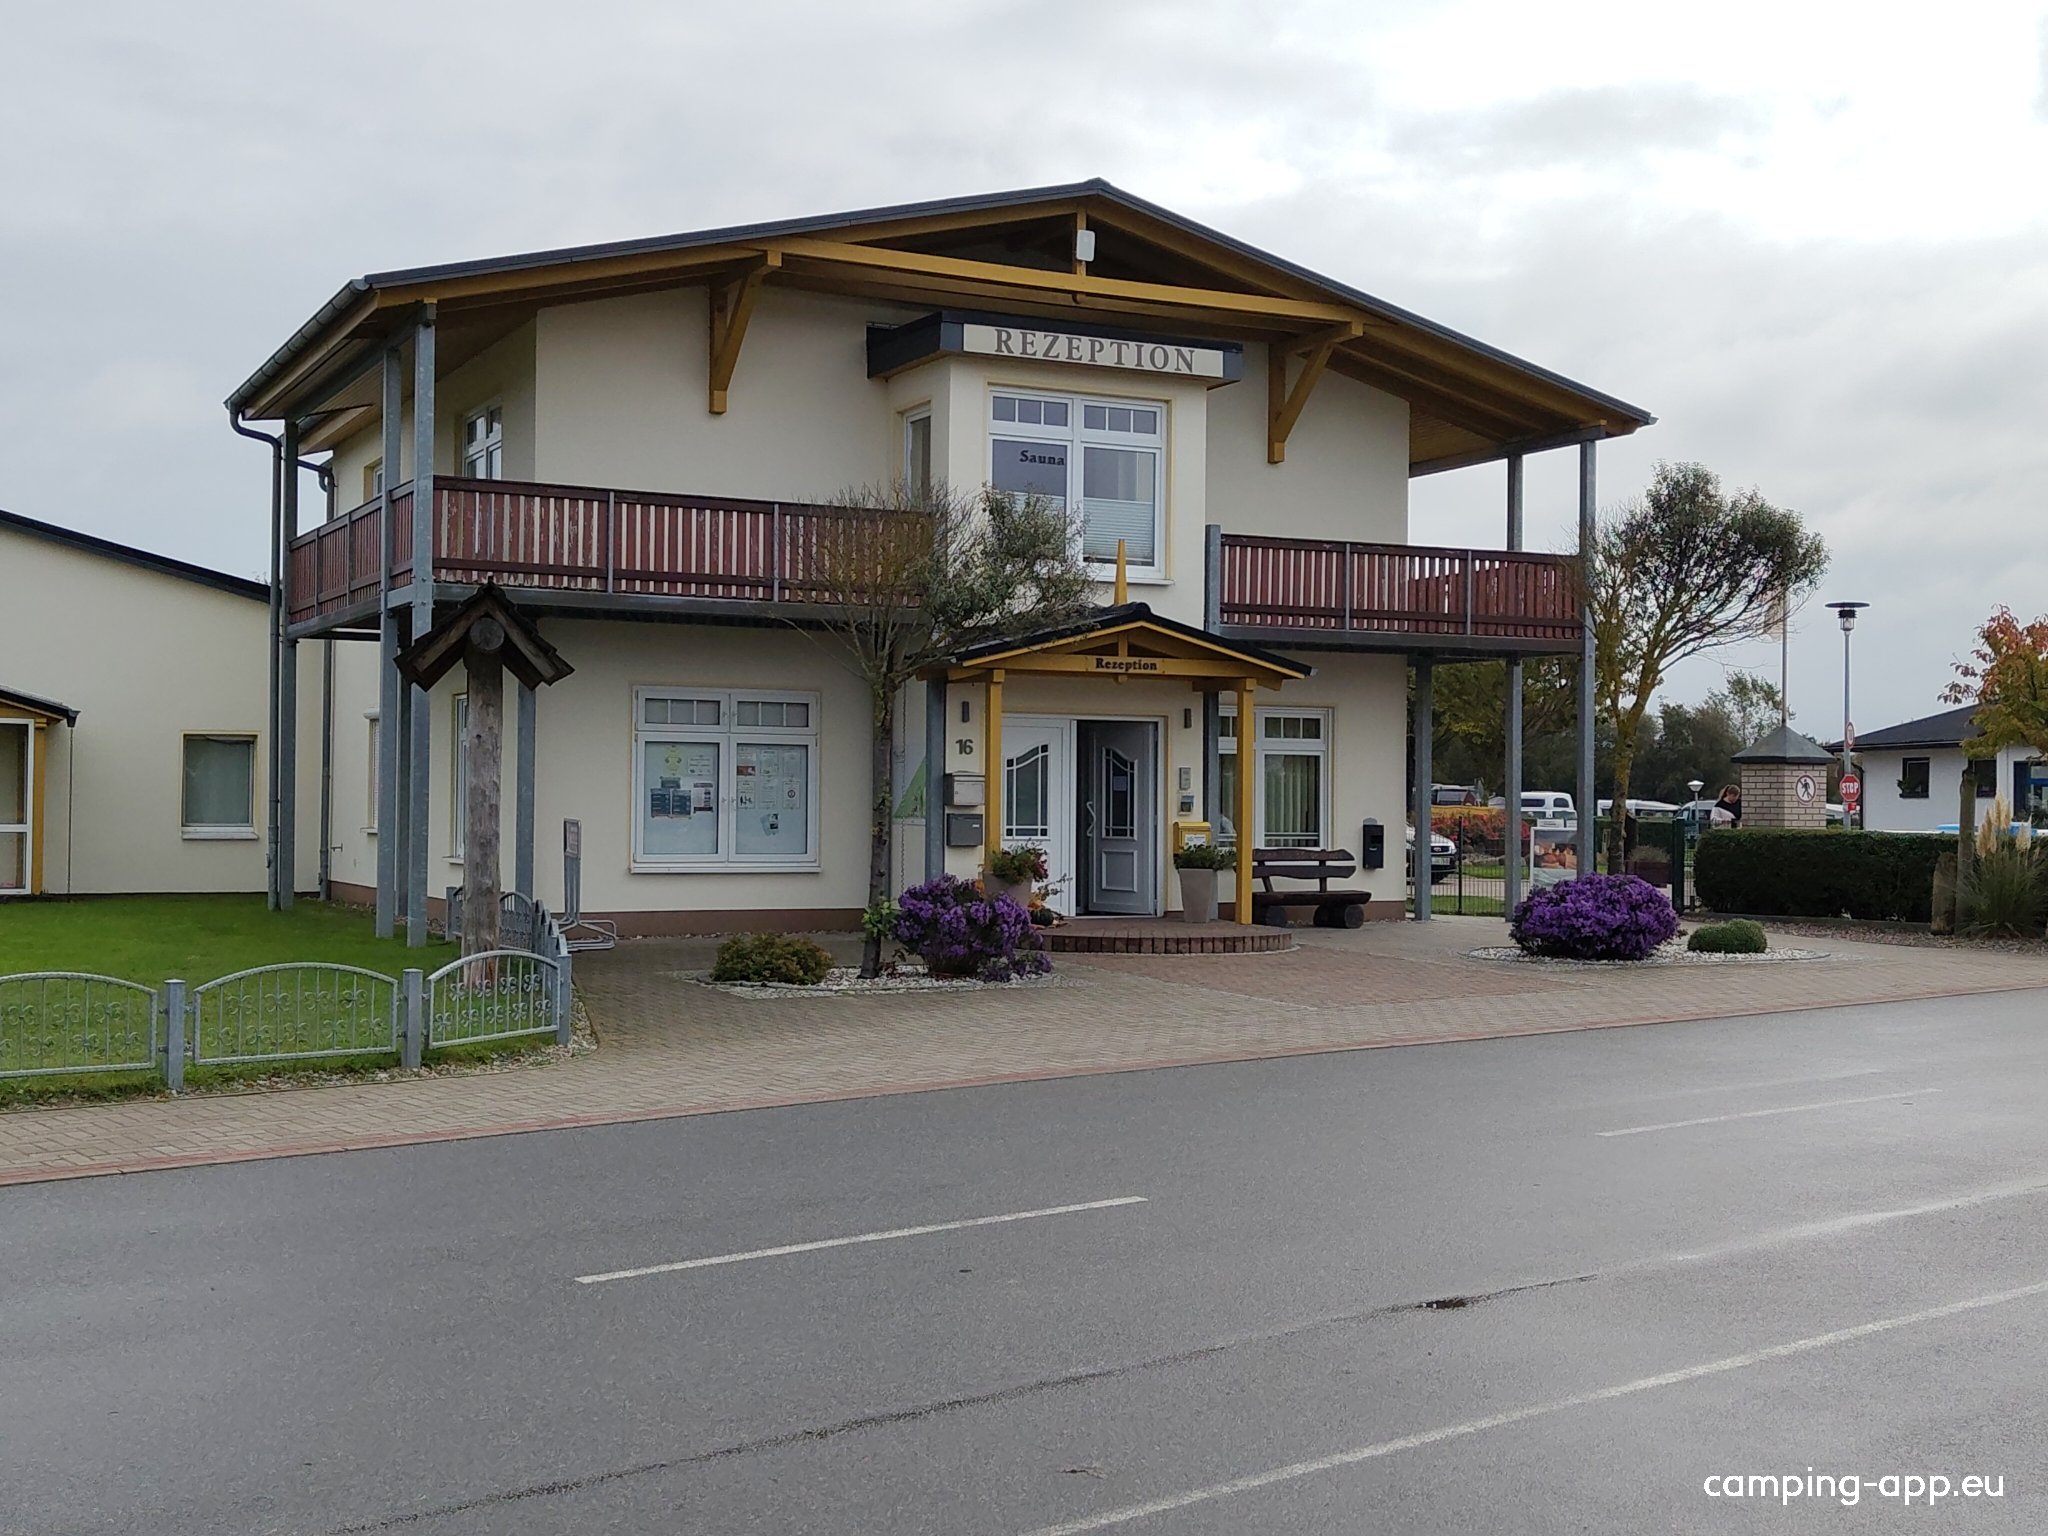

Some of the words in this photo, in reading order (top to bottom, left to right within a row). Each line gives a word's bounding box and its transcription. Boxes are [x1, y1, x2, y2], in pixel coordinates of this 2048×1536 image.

[994, 328, 1196, 374] REZEPTION
[1019, 450, 1065, 466] Sauna
[1095, 658, 1158, 672] Rezeption
[955, 738, 974, 755] 16
[1842, 782, 1859, 794] STOP
